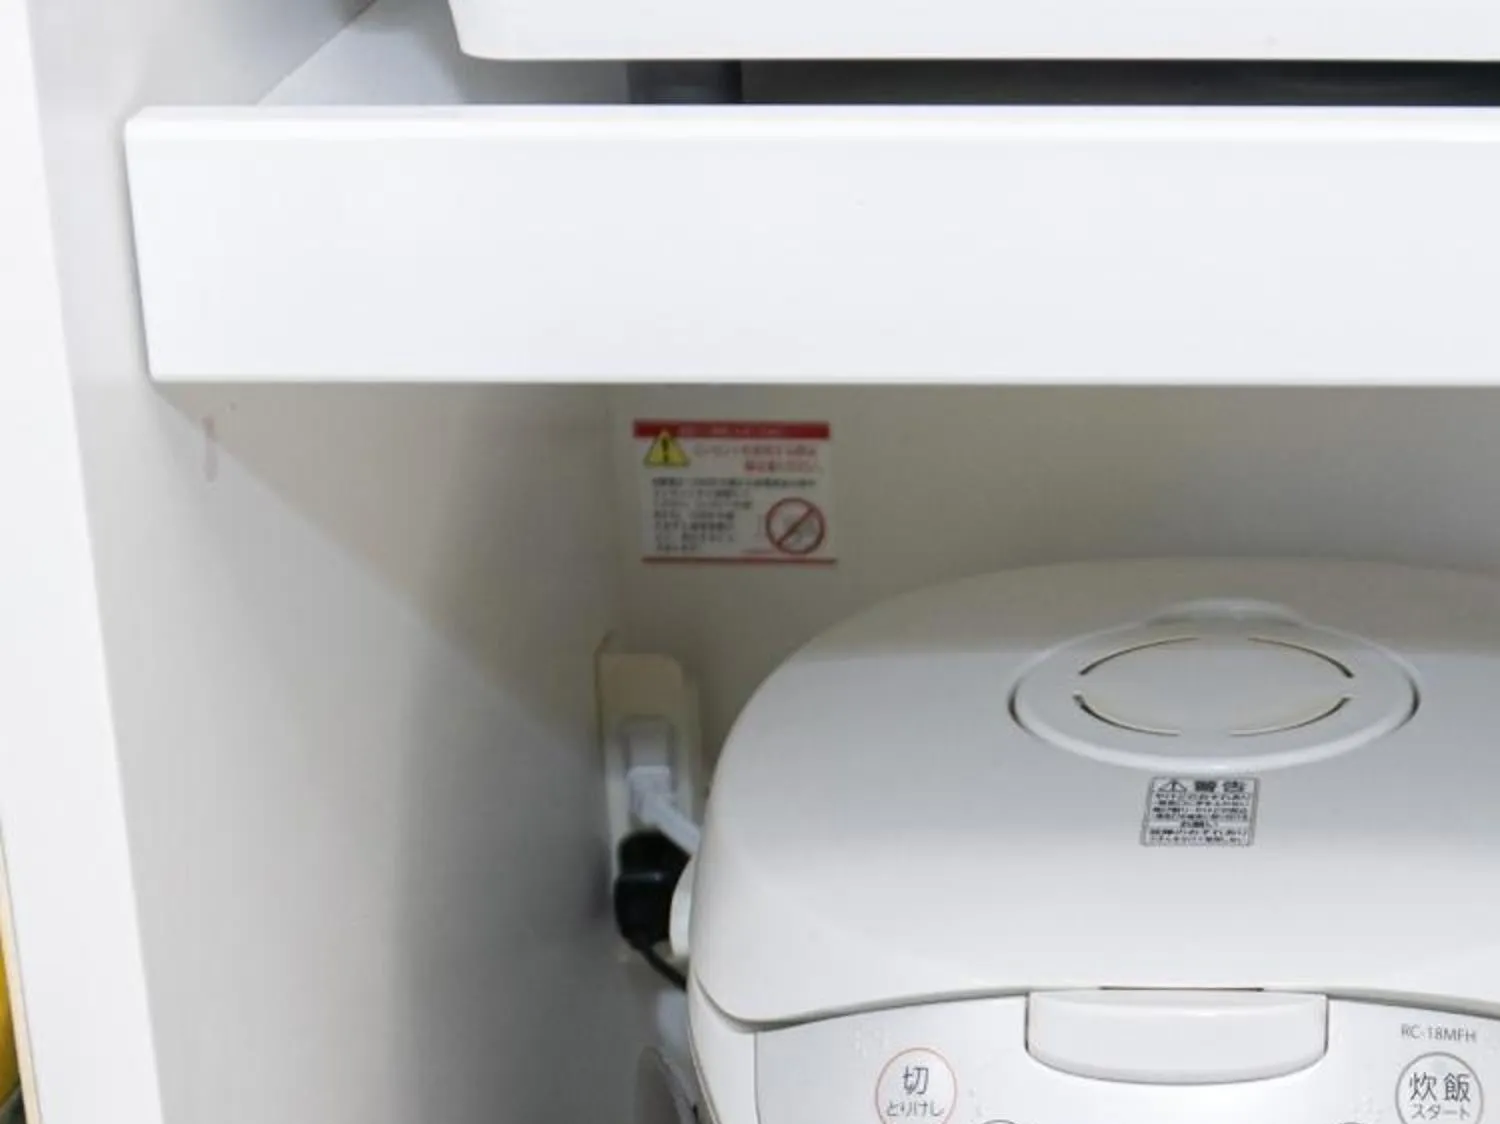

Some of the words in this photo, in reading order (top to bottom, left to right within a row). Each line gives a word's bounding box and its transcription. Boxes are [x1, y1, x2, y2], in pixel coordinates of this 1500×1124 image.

[1400, 1023, 1477, 1042] RC-18MFH
[902, 1066, 930, 1095] 切
[1409, 1071, 1471, 1103] 炊飯
[886, 1100, 944, 1117] とりけし
[1411, 1103, 1470, 1120] スタート
